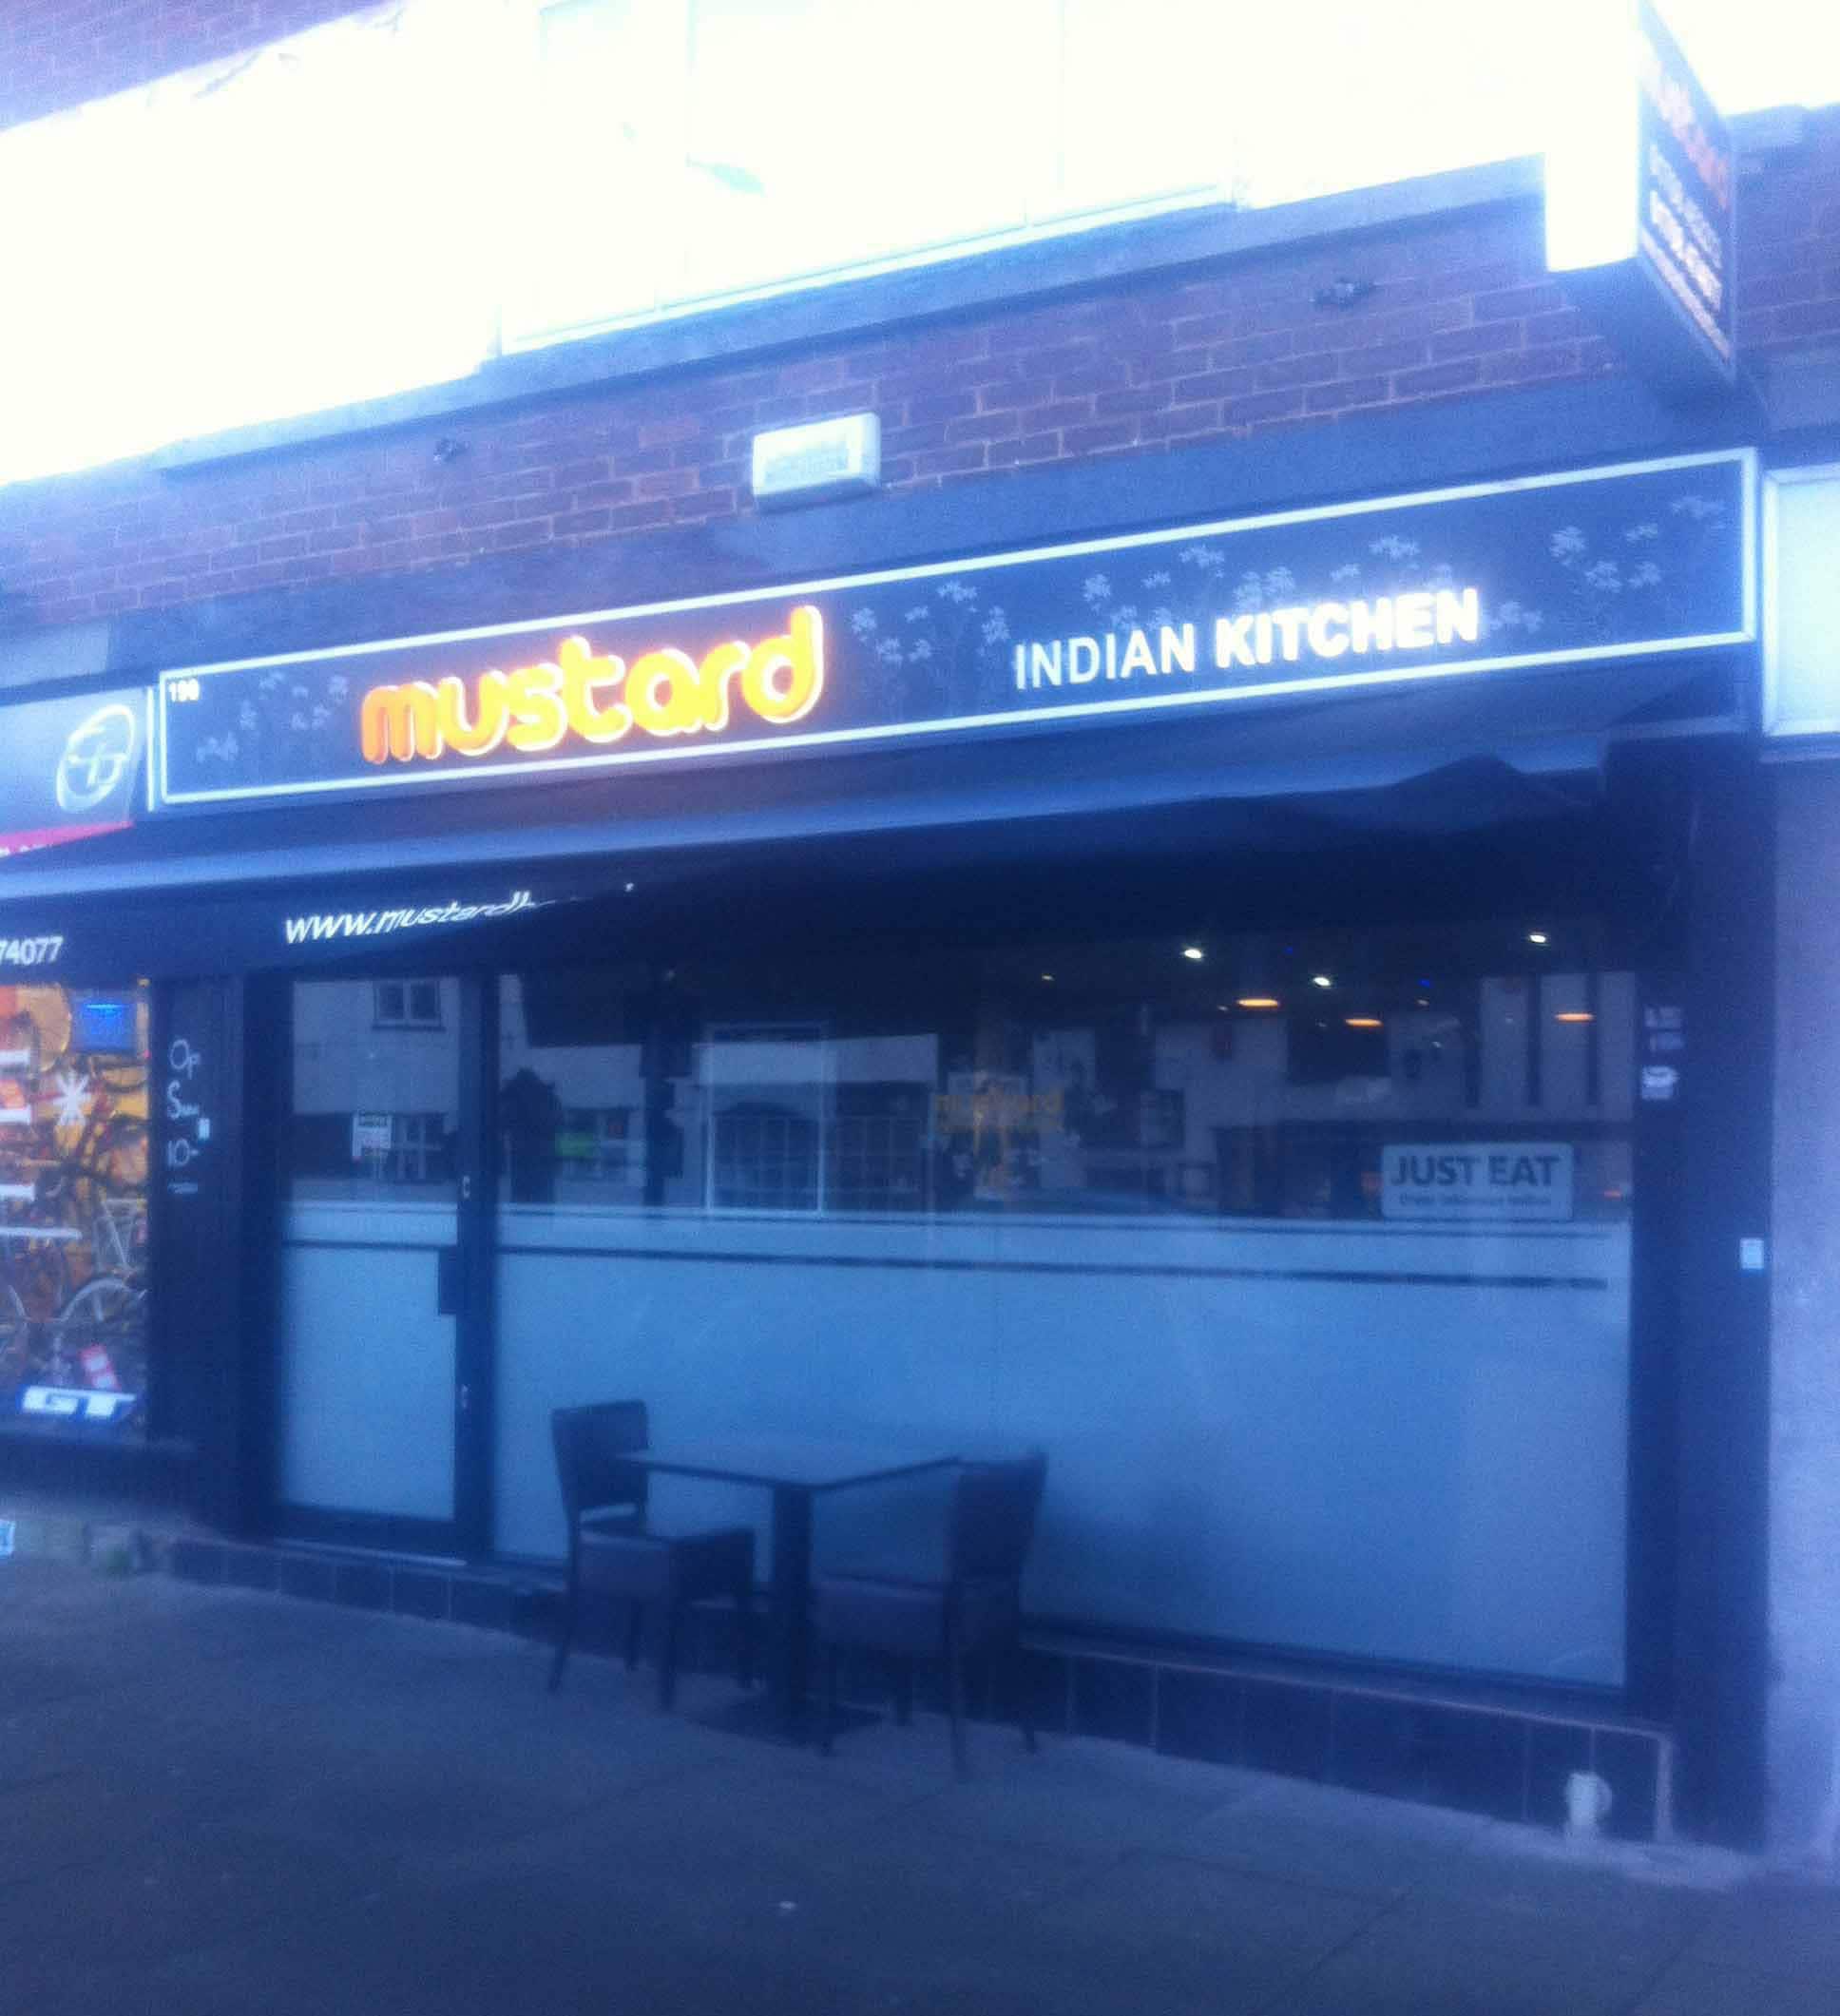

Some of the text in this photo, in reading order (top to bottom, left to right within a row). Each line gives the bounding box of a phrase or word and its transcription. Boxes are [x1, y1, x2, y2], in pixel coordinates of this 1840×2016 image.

[361, 605, 825, 764] mustard
[1014, 587, 1480, 691] INDIAN KITCHEN
[1390, 1155, 1562, 1186] JUST EAT
